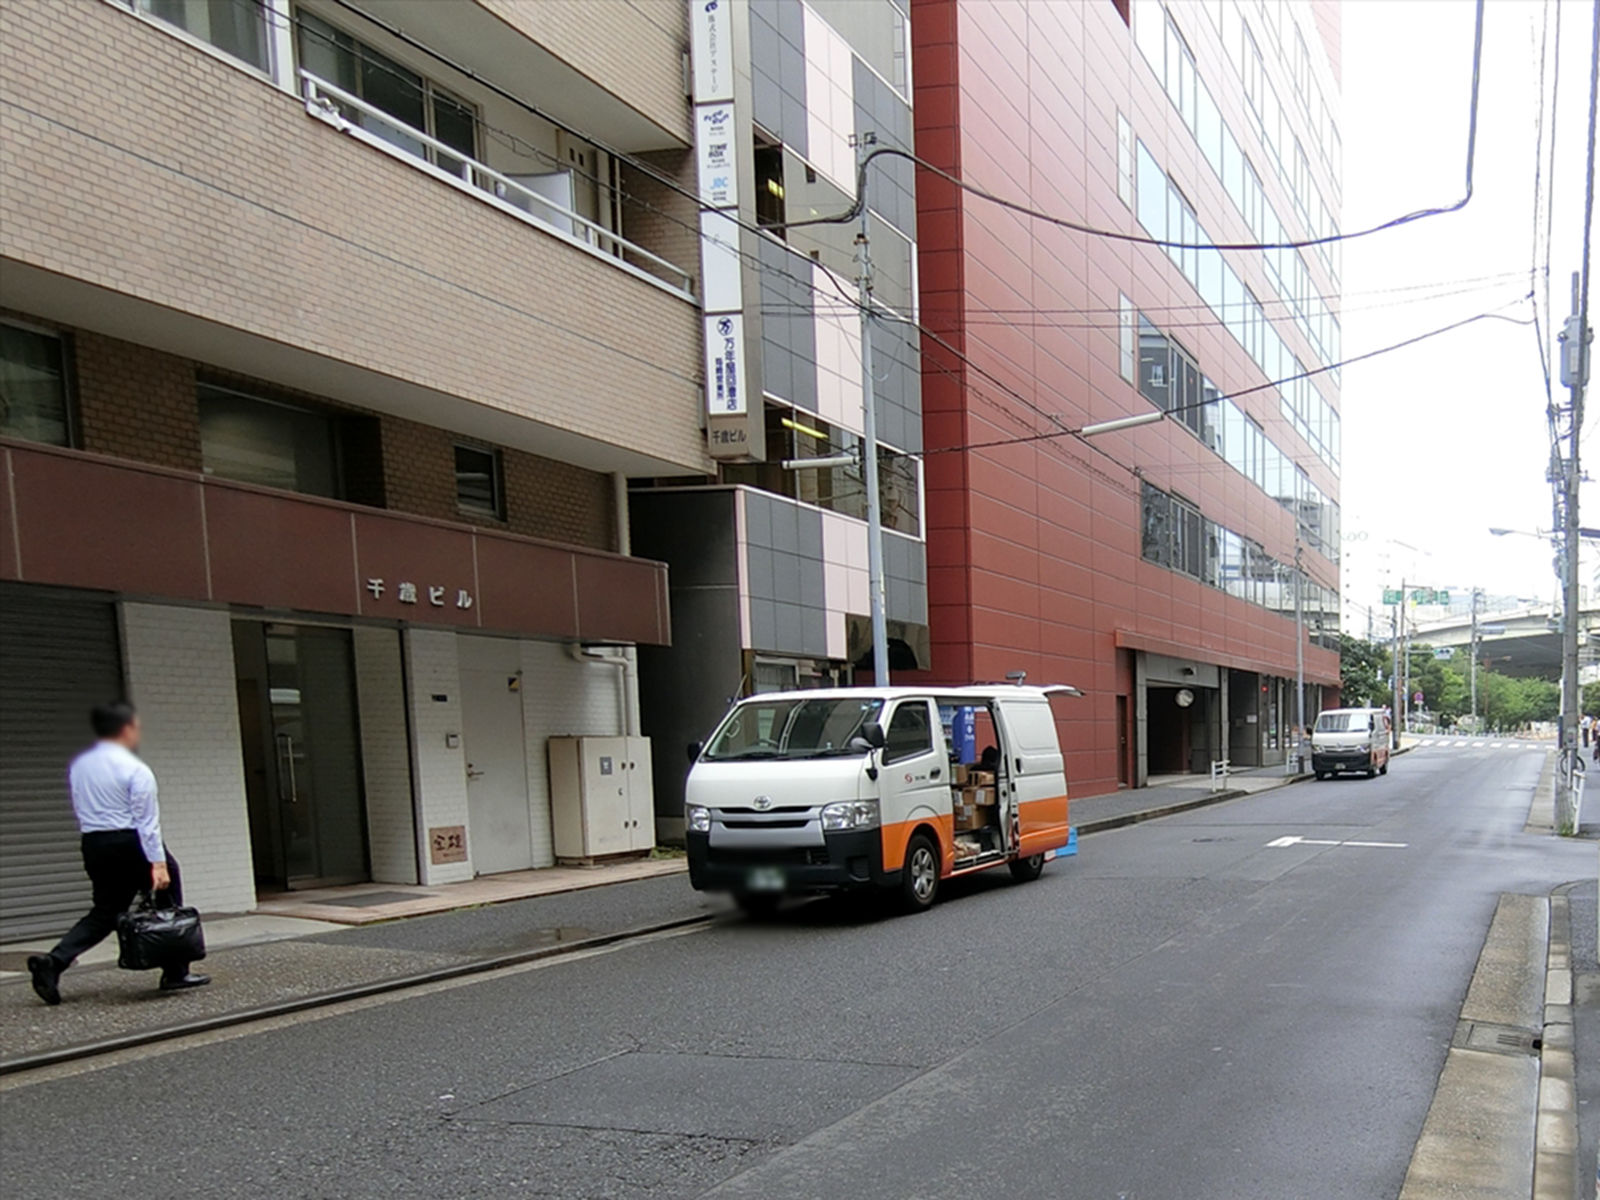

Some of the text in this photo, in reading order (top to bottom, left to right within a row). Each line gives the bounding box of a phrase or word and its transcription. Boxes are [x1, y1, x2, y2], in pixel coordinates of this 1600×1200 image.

[712, 429, 747, 444] 千歳ビル
[366, 578, 473, 609] 千歳ビル
